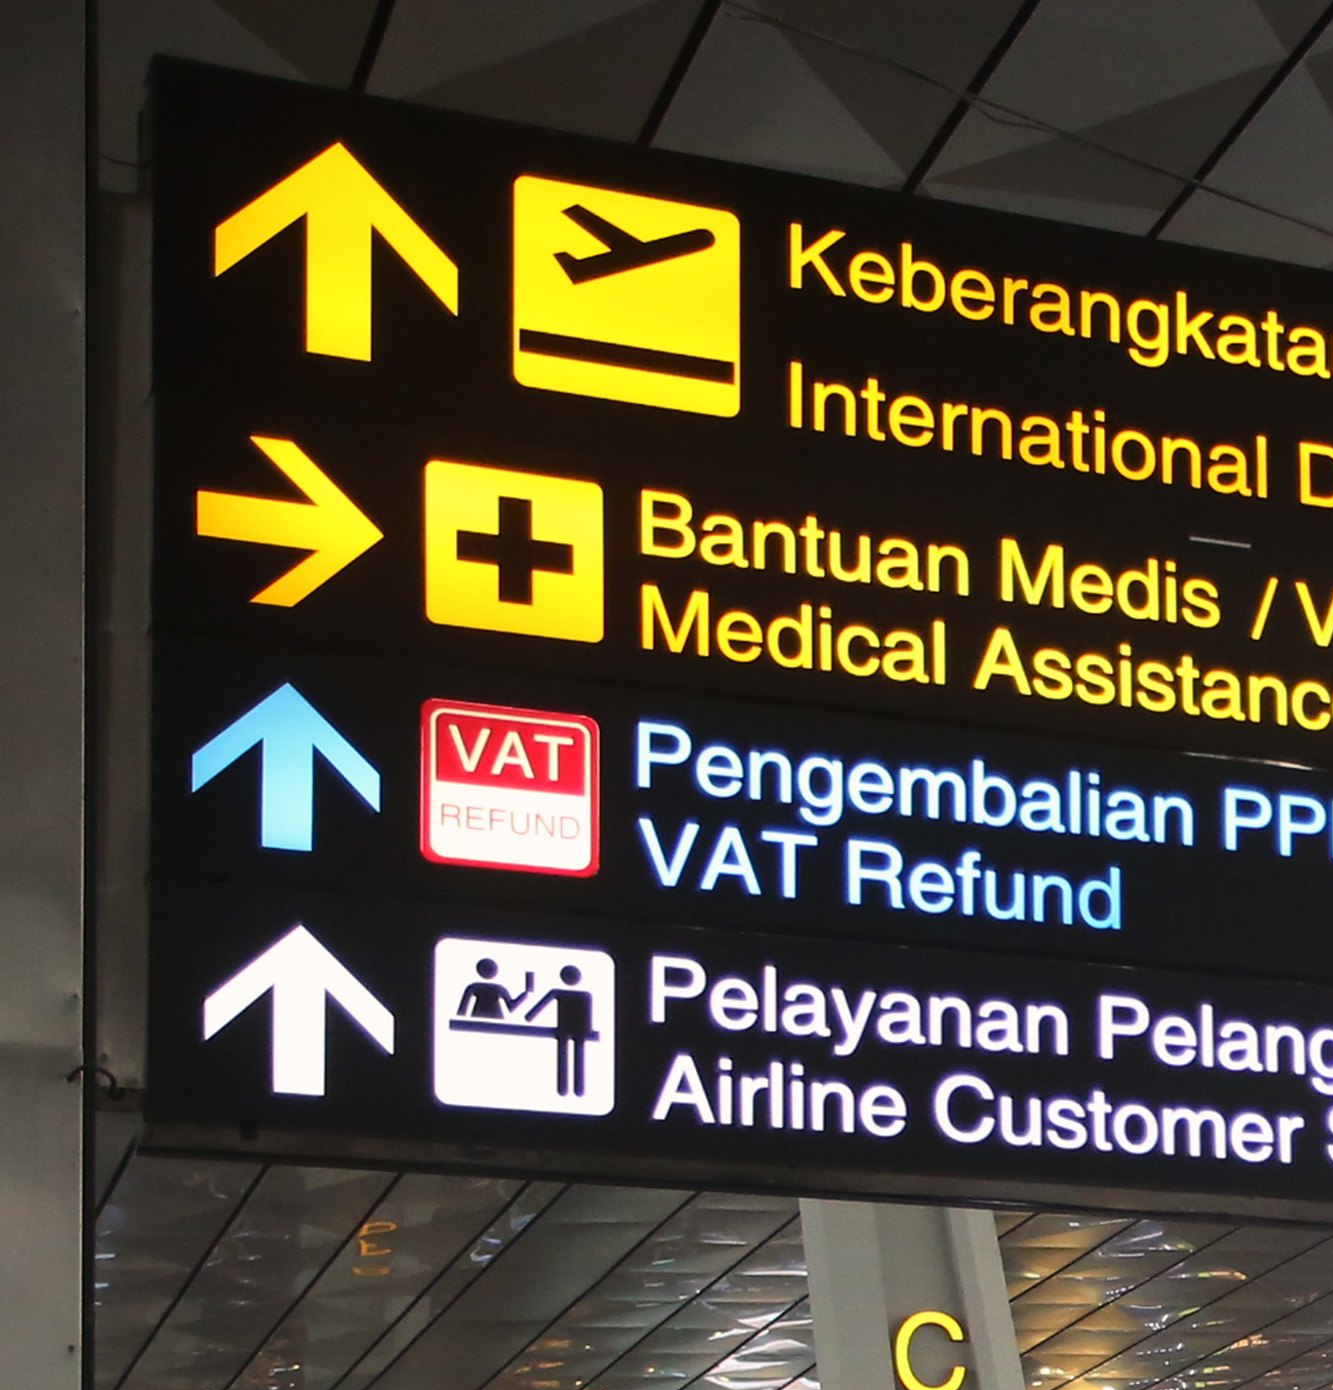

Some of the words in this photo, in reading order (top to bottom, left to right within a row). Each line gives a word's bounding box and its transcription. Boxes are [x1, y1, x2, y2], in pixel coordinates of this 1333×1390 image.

[789, 361, 1268, 498] International
[640, 488, 969, 596] Bantuan
[1000, 537, 1220, 628] Medis
[1251, 577, 1281, 640] /
[640, 582, 946, 685] Medical
[446, 725, 575, 782] VAT
[635, 719, 1194, 846] Pengembalian
[438, 801, 580, 842] REFUND
[637, 815, 818, 899] VAT
[843, 835, 1121, 930] Refund
[649, 954, 1069, 1056] Pelayanan
[652, 1052, 907, 1137] Airline
[932, 1071, 1304, 1164] Customer
